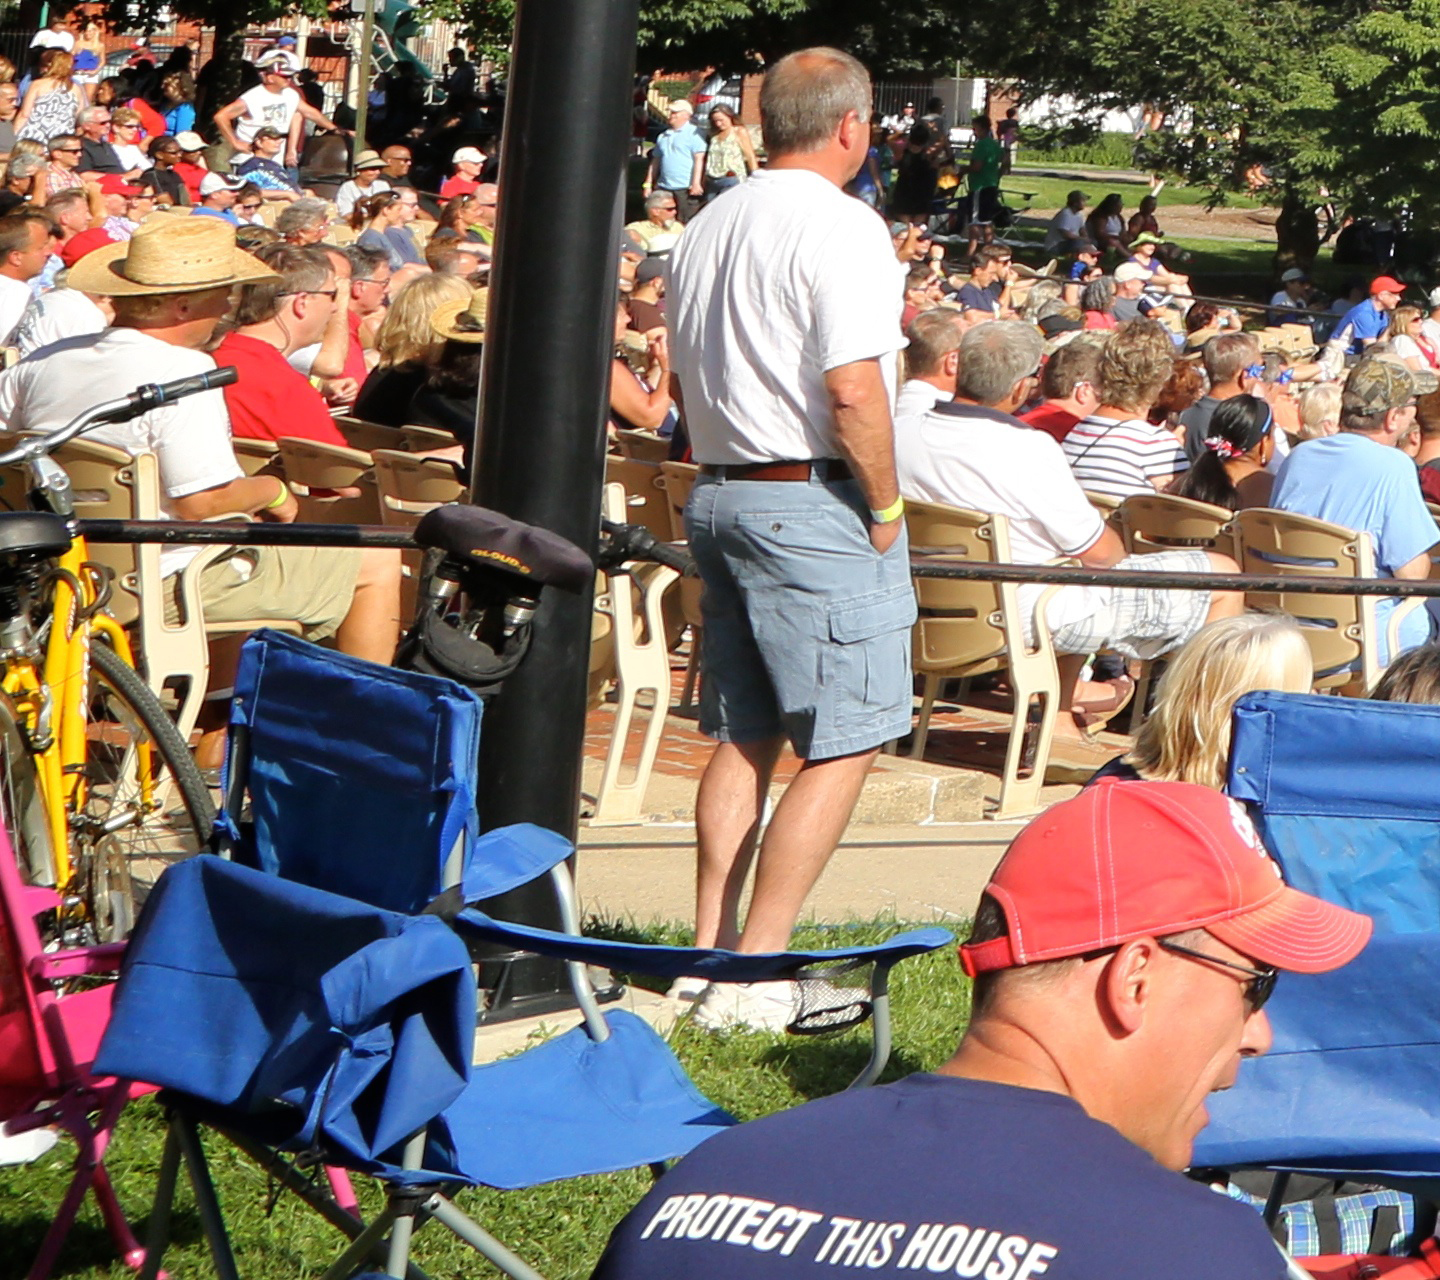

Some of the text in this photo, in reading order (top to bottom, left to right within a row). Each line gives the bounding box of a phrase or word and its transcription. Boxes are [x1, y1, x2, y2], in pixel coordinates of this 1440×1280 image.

[641, 1192, 1059, 1280] PROTECT THIS HOUSE
